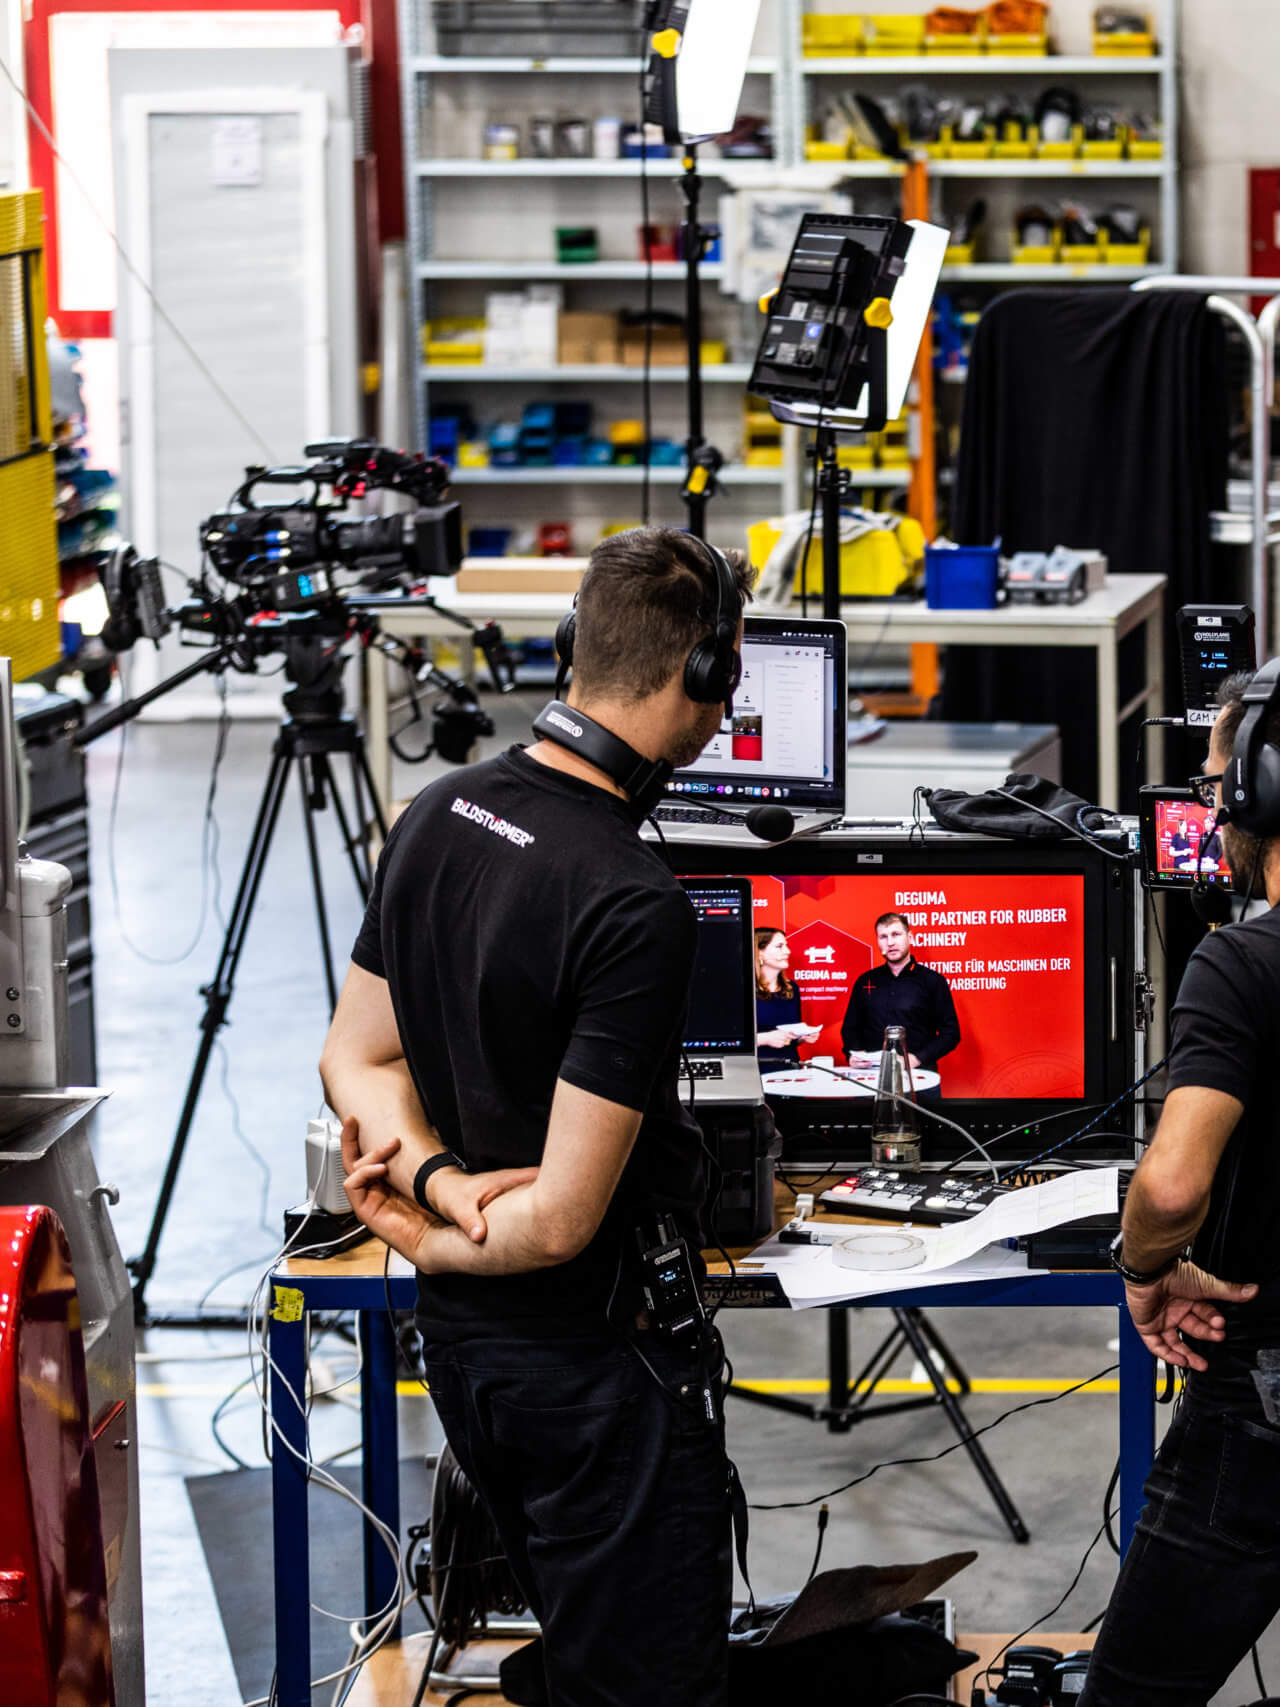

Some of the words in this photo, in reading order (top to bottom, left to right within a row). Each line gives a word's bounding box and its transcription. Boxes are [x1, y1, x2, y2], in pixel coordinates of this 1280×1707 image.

[895, 890, 947, 906] DEGUMA
[901, 911, 928, 926] OUR
[931, 910, 987, 926] PARTNER
[990, 909, 1014, 925] FOR
[1017, 907, 1067, 924] RUBBER
[910, 931, 967, 947] ACHINERY
[965, 958, 985, 973] FÜR
[987, 958, 1048, 973] MASCHINEN
[1050, 957, 1071, 971] DER
[794, 969, 830, 980] DEGUMA
[946, 976, 1007, 991] ARBEITUNG
